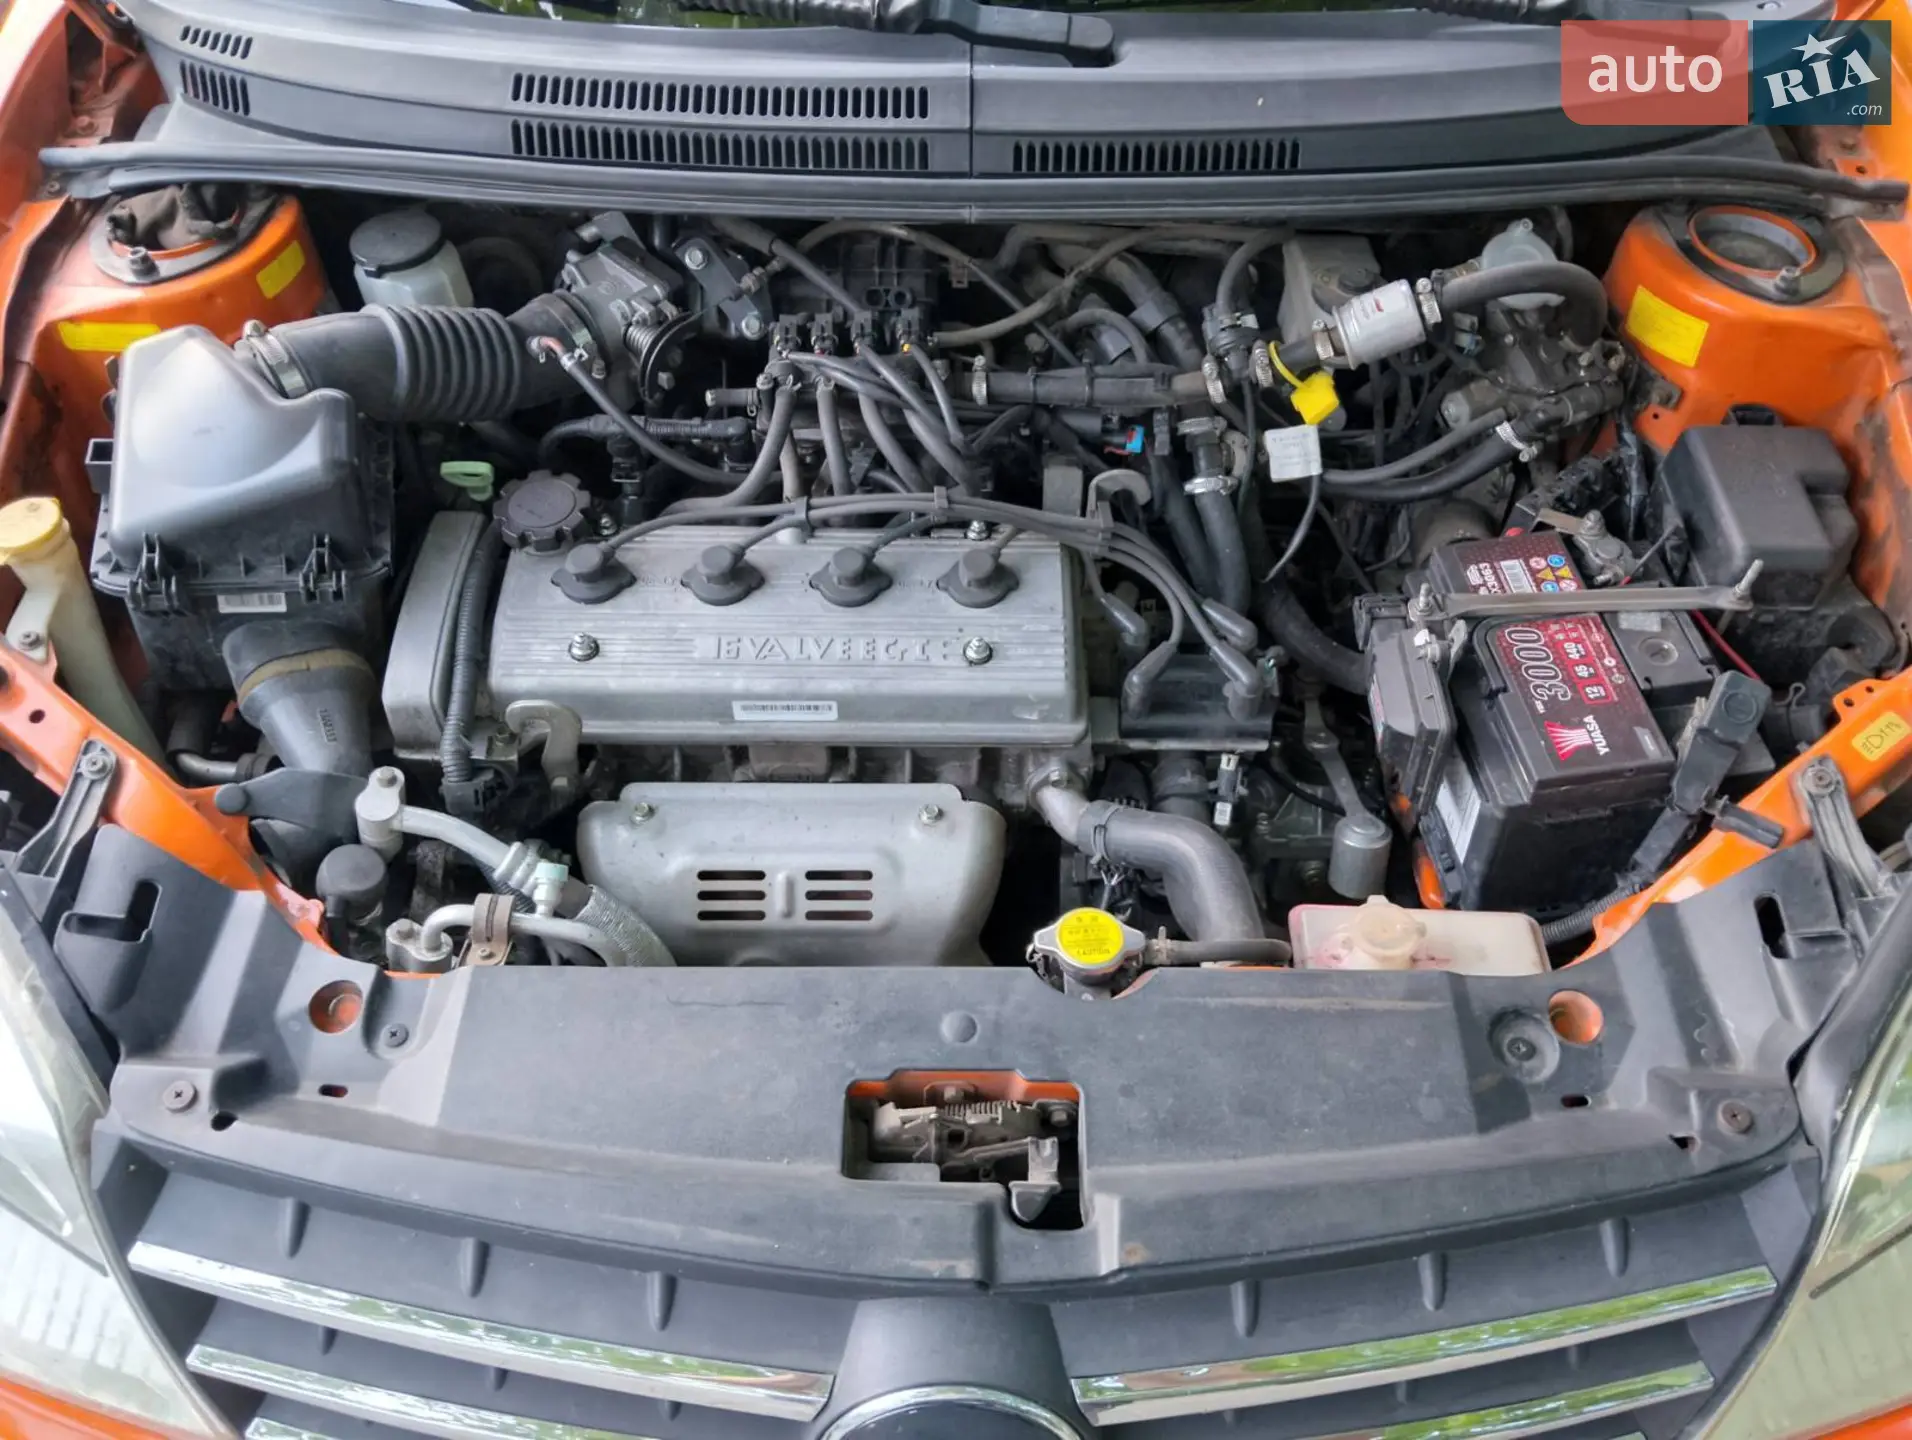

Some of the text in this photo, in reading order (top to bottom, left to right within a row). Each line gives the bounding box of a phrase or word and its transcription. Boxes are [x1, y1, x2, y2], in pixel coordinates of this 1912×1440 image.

[1478, 562, 1503, 595] X3063
[1563, 642, 1580, 660] 440
[1504, 627, 1571, 702] 3000
[1574, 664, 1590, 678] 45
[1585, 685, 1601, 699] 12
[1582, 714, 1611, 756] YUASA
